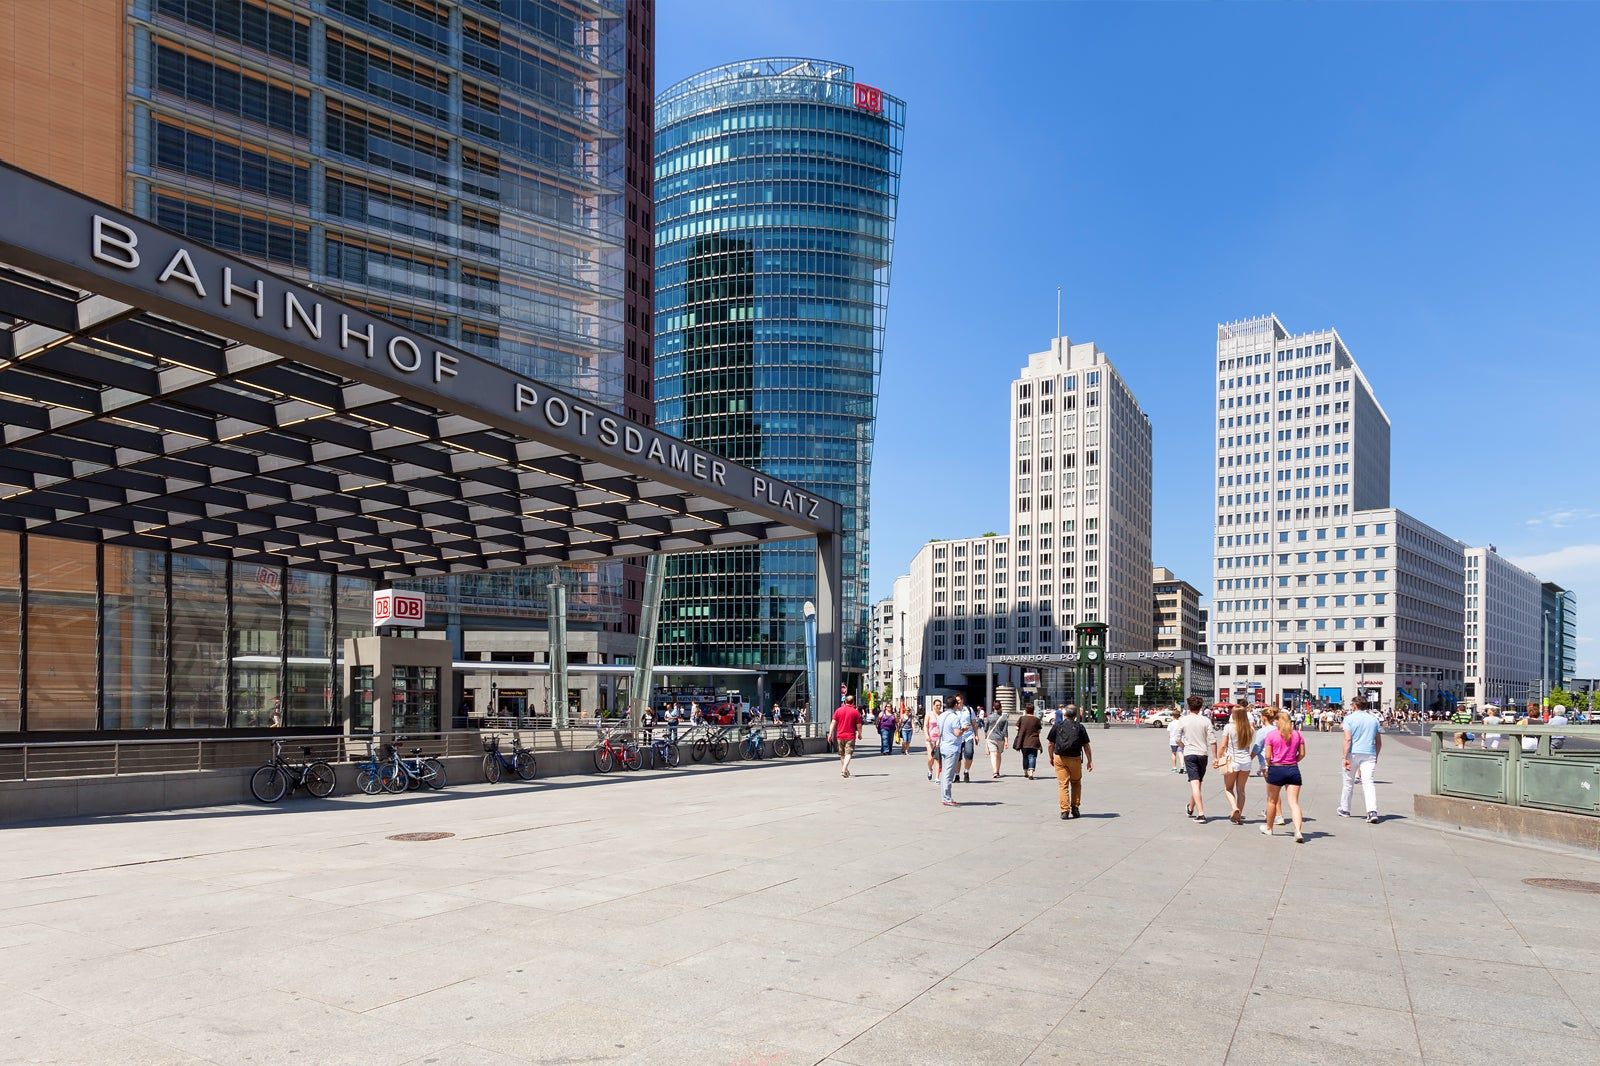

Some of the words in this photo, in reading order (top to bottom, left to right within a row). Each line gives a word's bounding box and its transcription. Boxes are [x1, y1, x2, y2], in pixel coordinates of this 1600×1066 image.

[858, 87, 880, 110] DB
[91, 214, 460, 383] BAHNHOF
[515, 383, 727, 486] POTSDAMER
[752, 476, 820, 520] PLATZ
[376, 599, 389, 616] DB
[396, 599, 420, 617] DB
[1000, 654, 1050, 662] BAHNHOF
